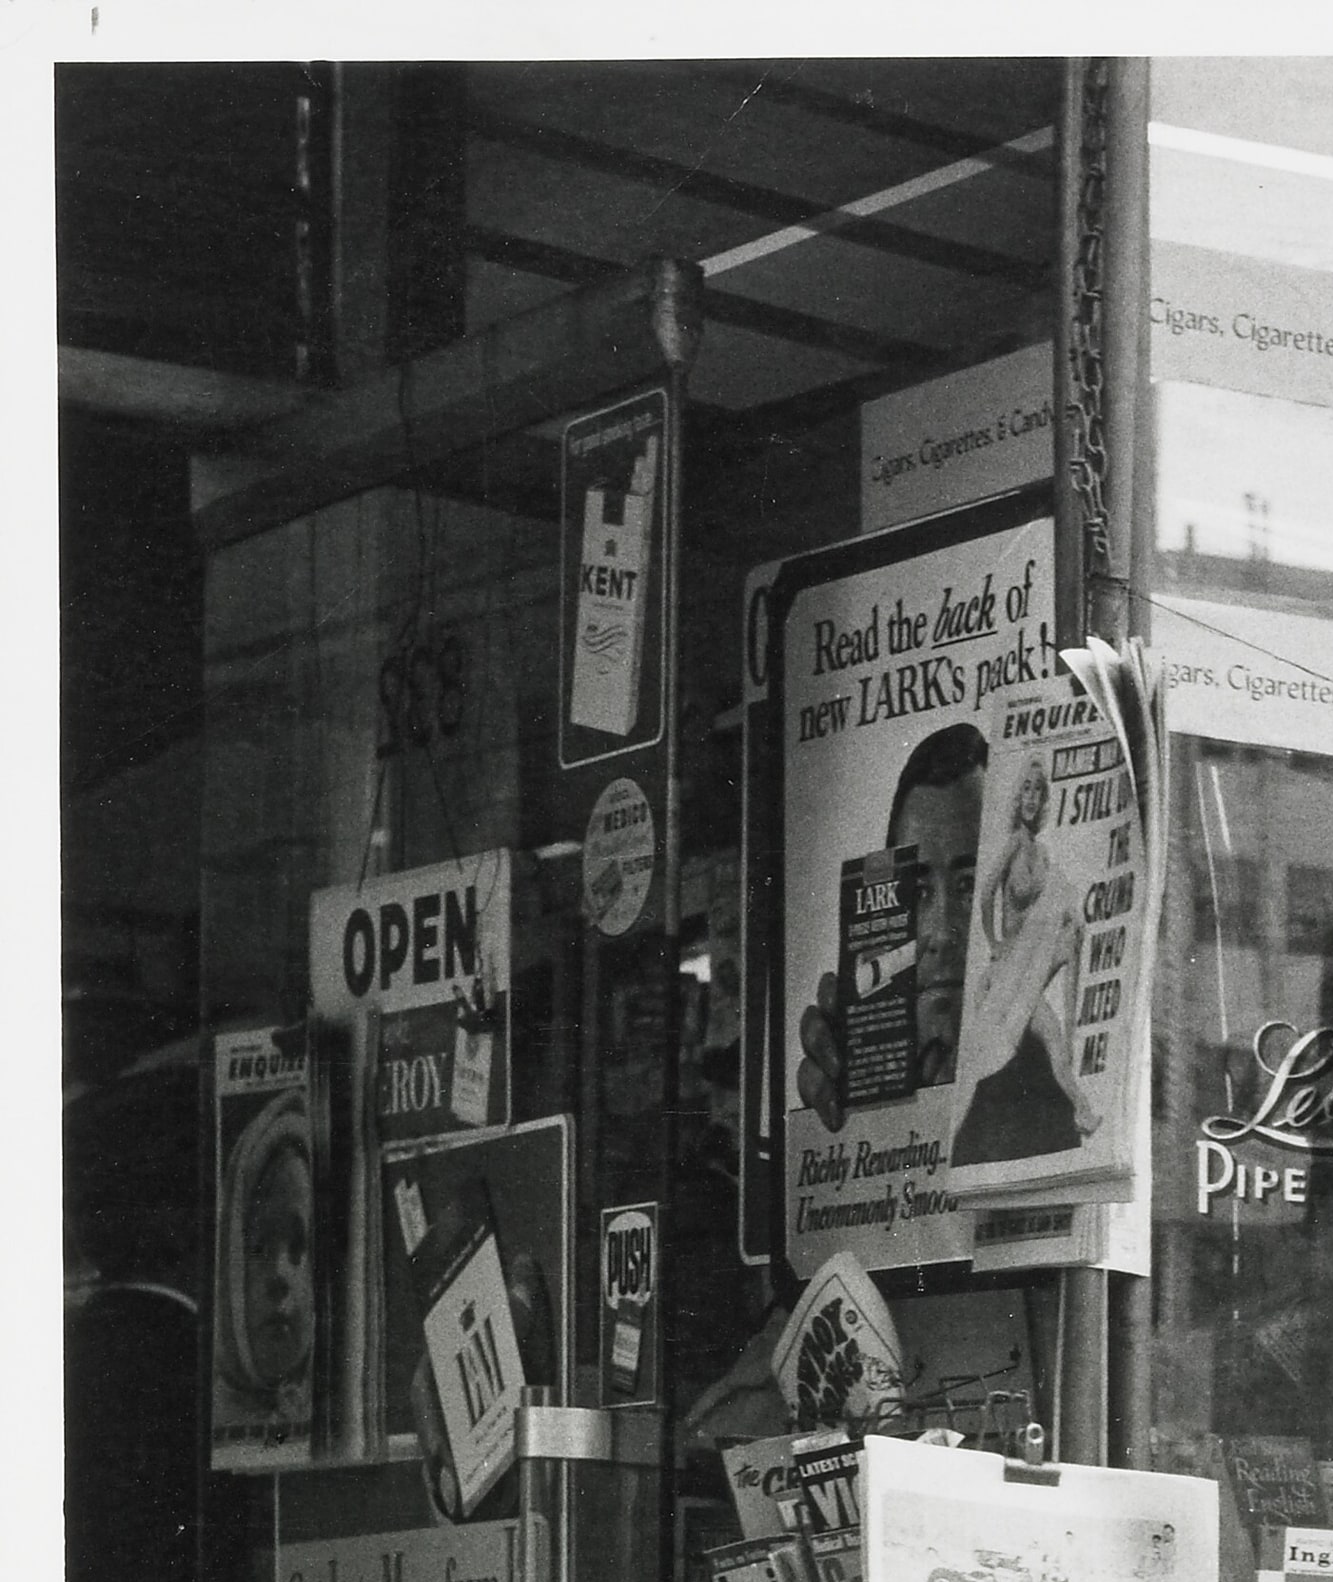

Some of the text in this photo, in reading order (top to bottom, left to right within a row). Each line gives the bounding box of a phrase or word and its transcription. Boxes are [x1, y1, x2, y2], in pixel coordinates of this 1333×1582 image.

[579, 562, 638, 601] KENT
[812, 559, 1035, 676] Read the back of
[800, 622, 1049, 742] new LARK's pack!
[1159, 656, 1220, 691] igars,
[1003, 701, 1106, 738] ENQUIRE
[855, 882, 900, 915] LARK
[343, 886, 480, 997] OPEN
[1196, 1140, 1306, 1214] PIPE
[608, 1226, 651, 1296] PUSH
